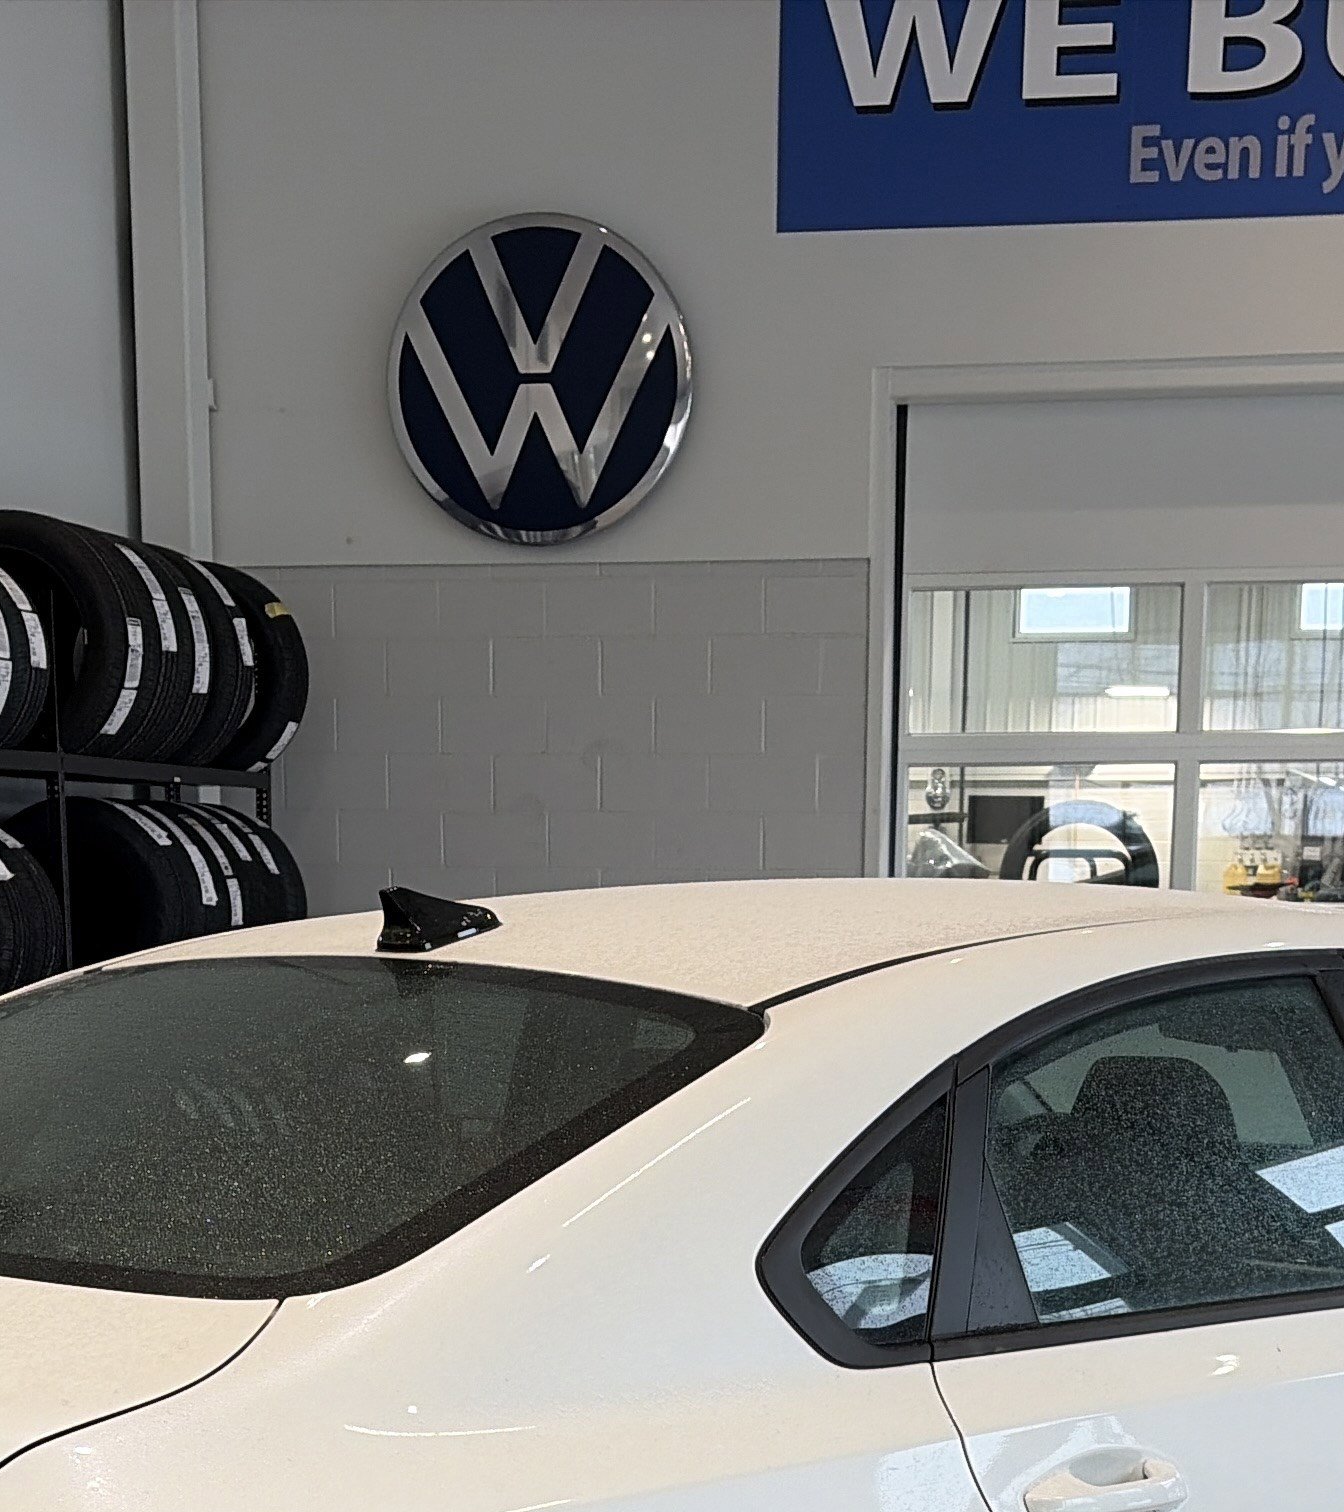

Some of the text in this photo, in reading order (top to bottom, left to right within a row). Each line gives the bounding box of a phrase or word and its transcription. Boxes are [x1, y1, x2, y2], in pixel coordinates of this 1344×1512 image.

[824, 0, 1119, 107] WE
[1129, 124, 1262, 184] Even
[1275, 113, 1316, 178] if
[402, 226, 676, 514] VW
